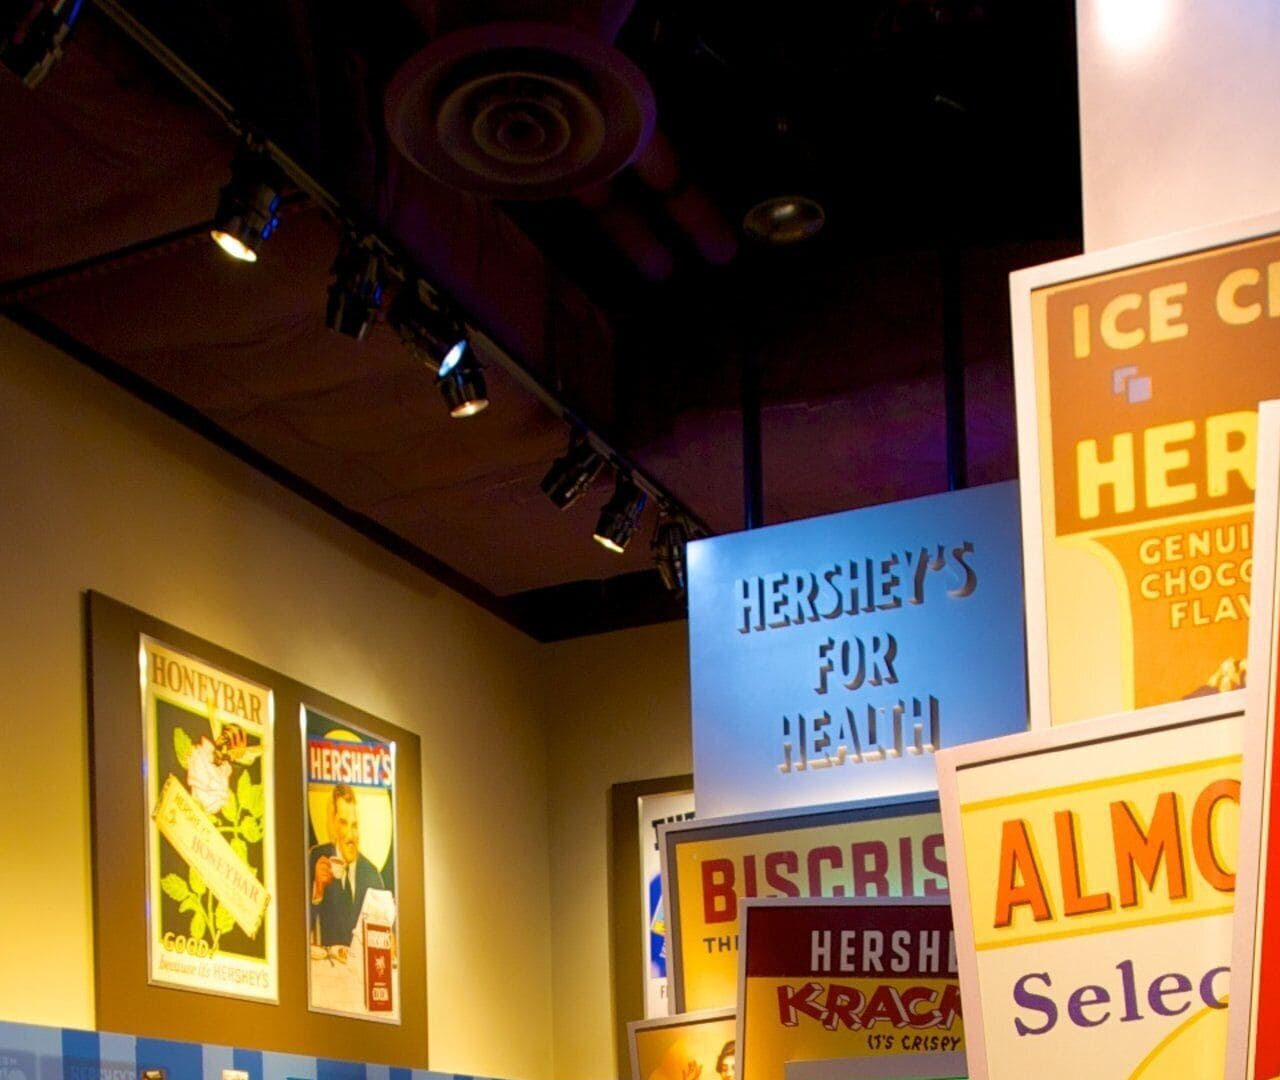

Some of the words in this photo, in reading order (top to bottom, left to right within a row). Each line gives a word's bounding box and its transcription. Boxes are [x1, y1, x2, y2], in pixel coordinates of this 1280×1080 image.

[1072, 285, 1188, 359] ICE
[734, 541, 978, 634] HERSHEY'S
[151, 653, 263, 726] HONEYBAR
[813, 631, 899, 695] FOR
[310, 744, 393, 785] HERSHEY'S
[777, 694, 940, 774] HEALTH
[163, 930, 221, 960] GOOD!
[868, 1035, 894, 1051] IT'S
[902, 1035, 961, 1051] CRISPY
